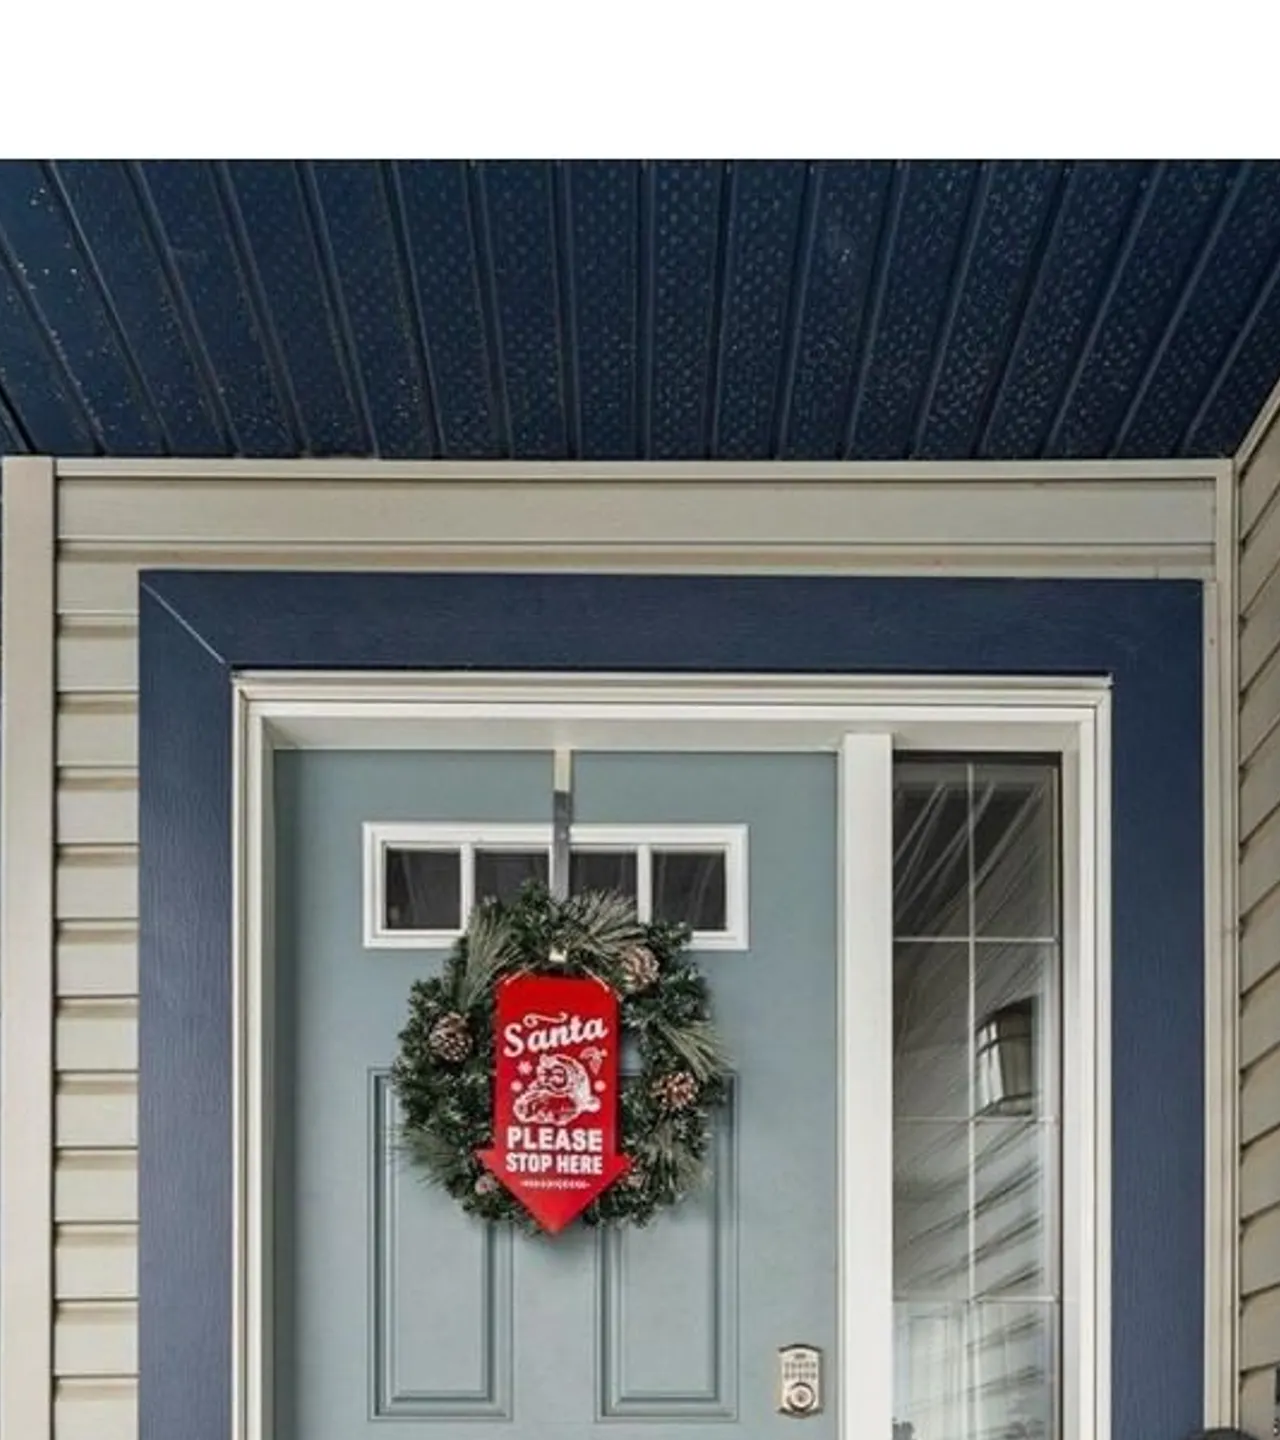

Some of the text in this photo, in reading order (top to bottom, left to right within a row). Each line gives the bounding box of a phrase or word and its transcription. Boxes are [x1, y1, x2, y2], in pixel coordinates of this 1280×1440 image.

[503, 1012, 609, 1057] Santa
[506, 1126, 603, 1153] PLEASE
[505, 1152, 603, 1175] STOP HERE
